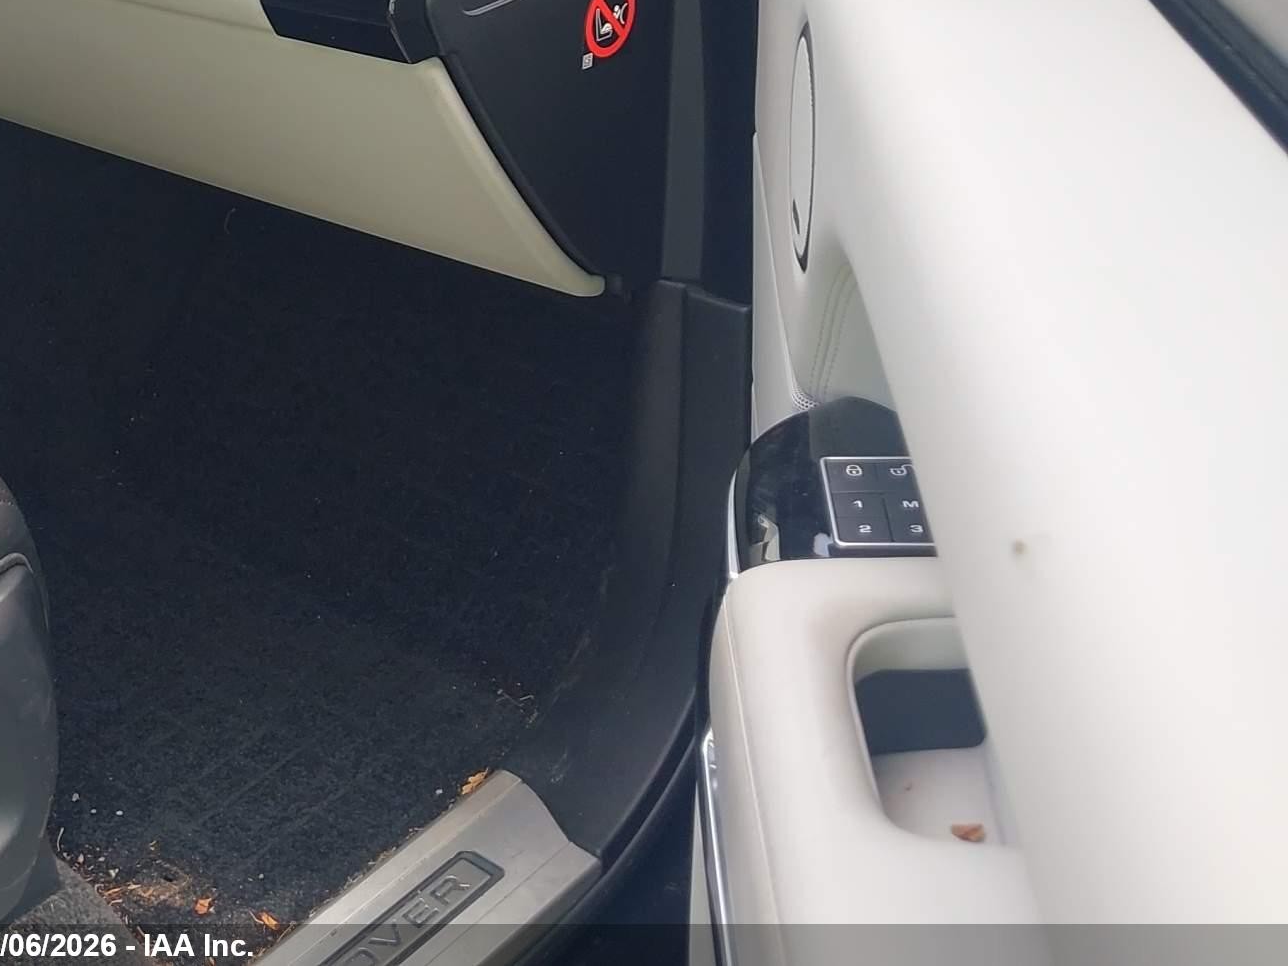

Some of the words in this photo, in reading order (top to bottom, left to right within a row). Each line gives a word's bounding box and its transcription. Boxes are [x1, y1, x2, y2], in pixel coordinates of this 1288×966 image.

[852, 500, 863, 508] 1
[902, 500, 919, 508] M
[858, 524, 872, 533] 2
[909, 524, 924, 533] 3
